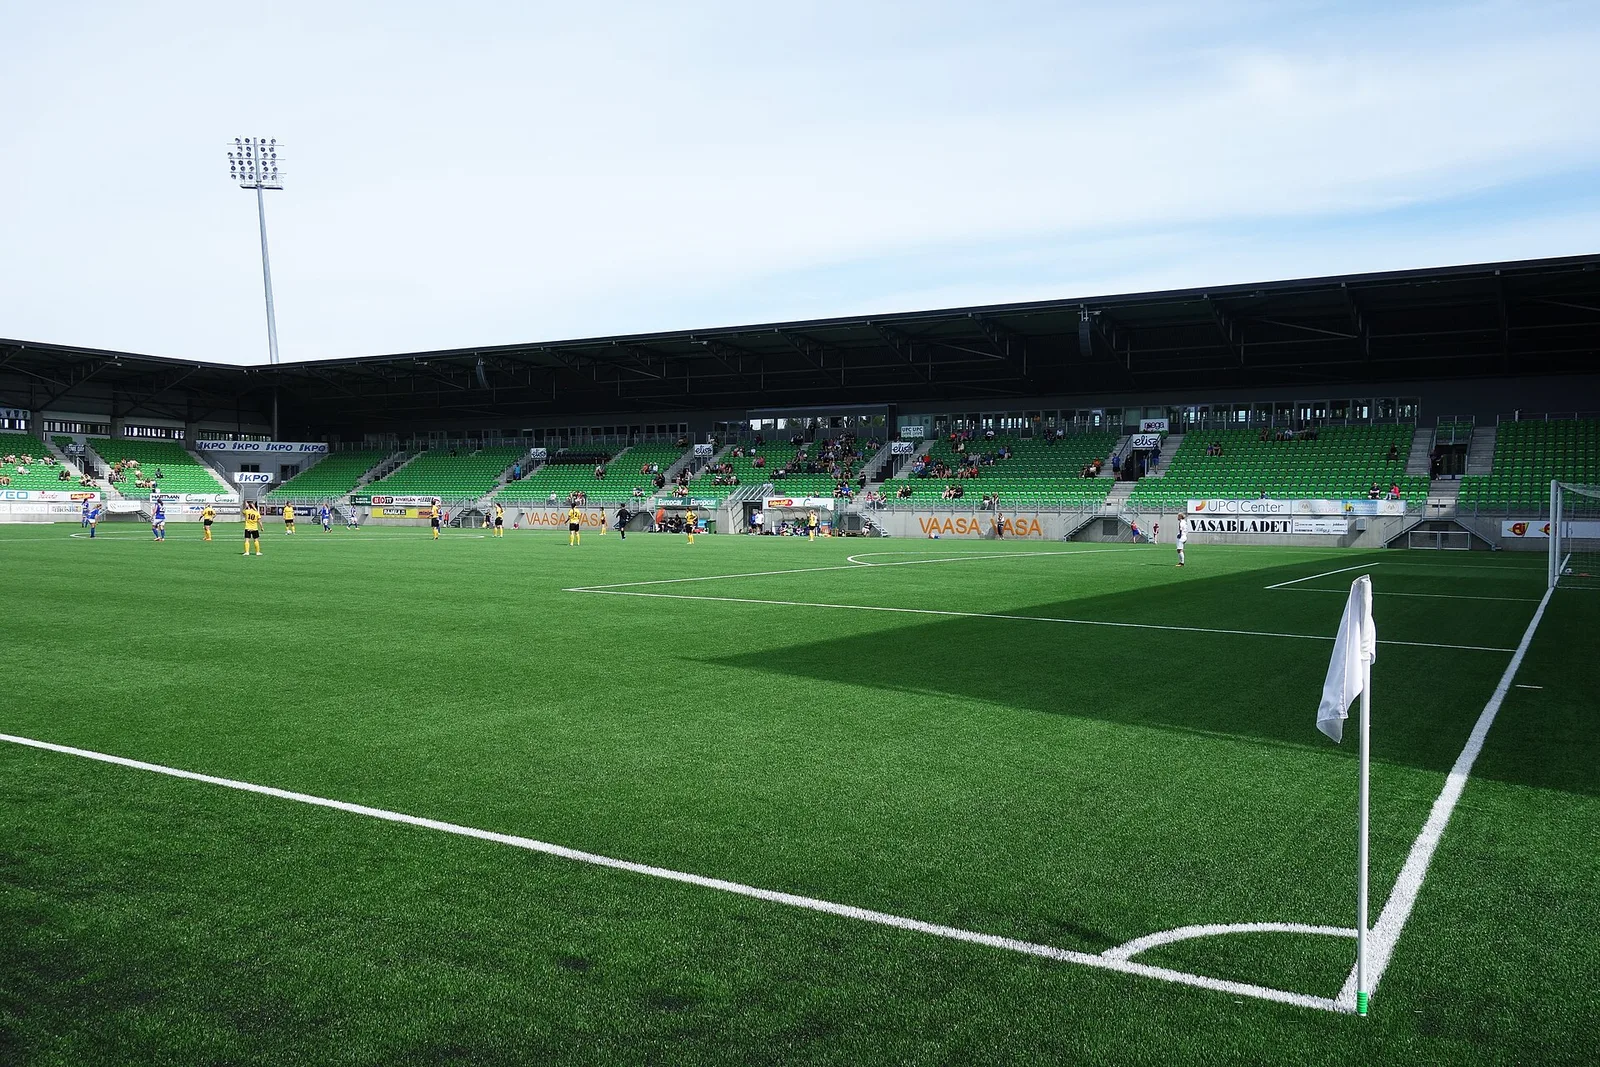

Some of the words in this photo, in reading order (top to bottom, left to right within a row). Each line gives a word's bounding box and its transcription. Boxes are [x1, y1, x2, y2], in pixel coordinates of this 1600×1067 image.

[1208, 501, 1236, 512] UPC
[1241, 501, 1284, 512] Center
[526, 512, 566, 526] VAASA
[919, 517, 981, 535] VAASA
[1190, 520, 1290, 532] VASABLADET
